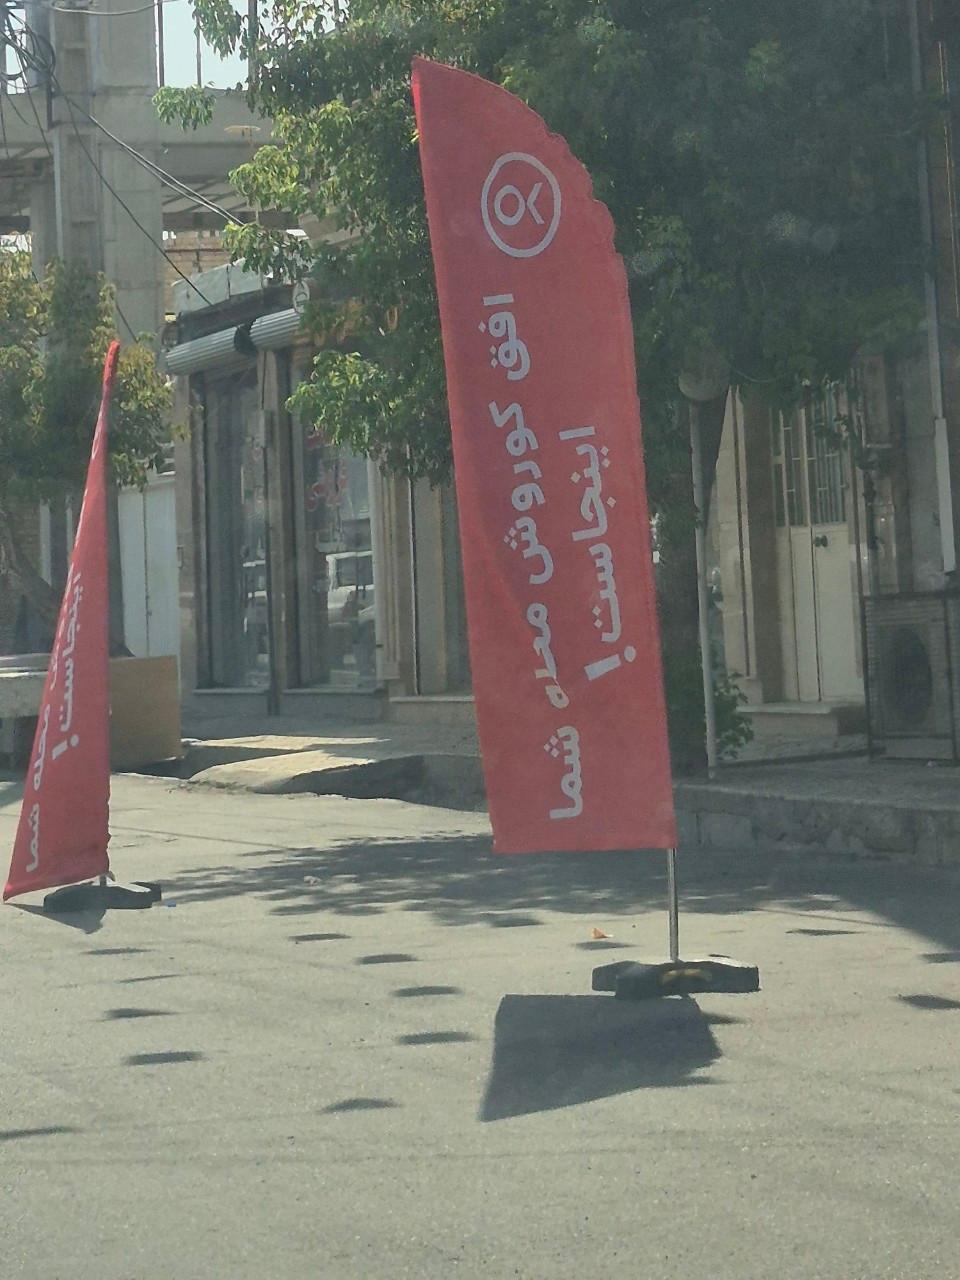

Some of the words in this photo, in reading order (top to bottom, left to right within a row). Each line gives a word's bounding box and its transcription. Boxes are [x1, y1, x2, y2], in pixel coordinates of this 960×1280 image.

[478, 293, 531, 381] افق
[488, 400, 554, 585] کوروش
[526, 602, 570, 709] محله
[543, 725, 584, 820] شما
[26, 802, 40, 873] شما
